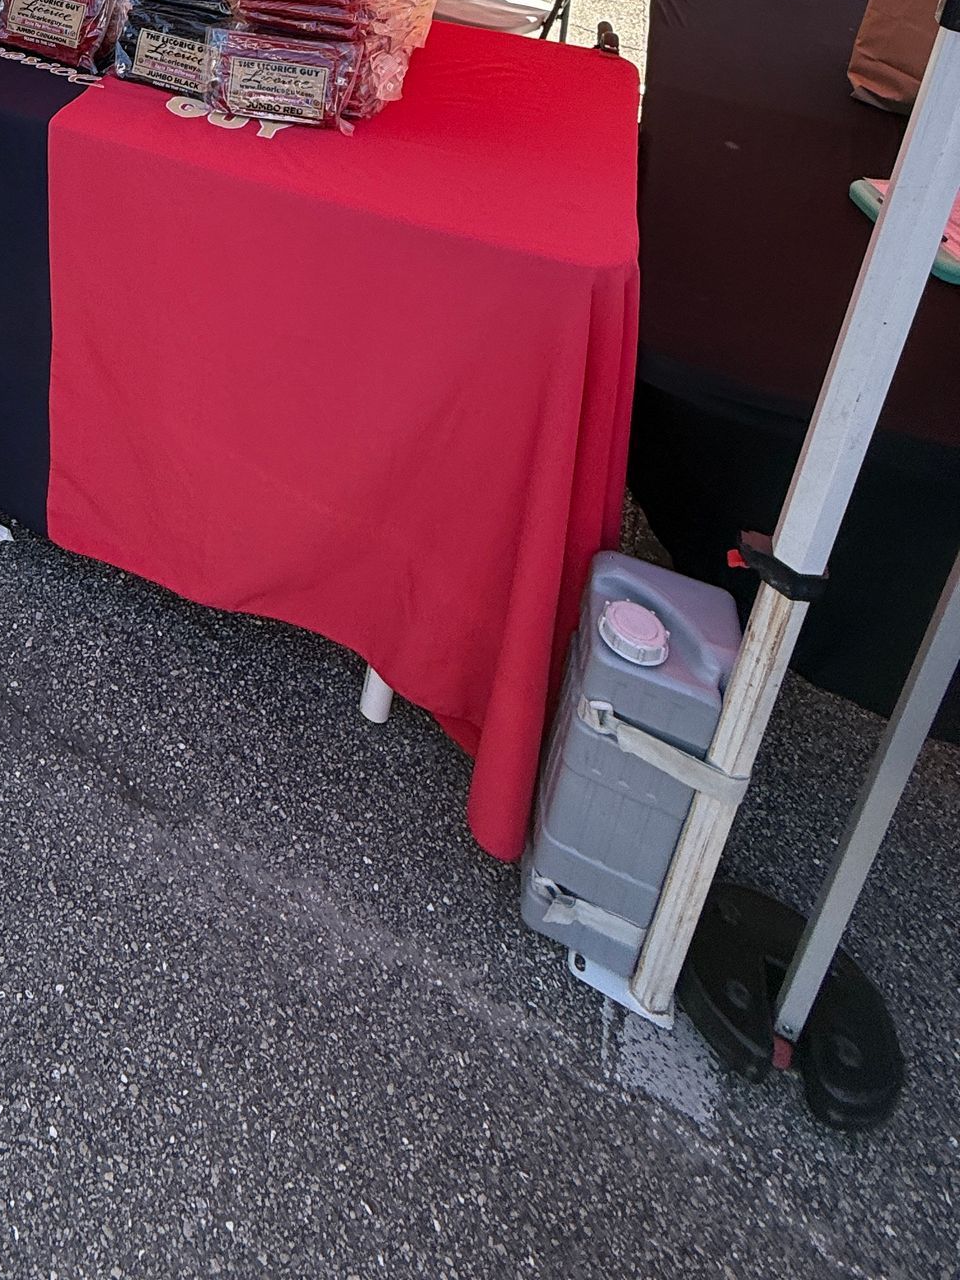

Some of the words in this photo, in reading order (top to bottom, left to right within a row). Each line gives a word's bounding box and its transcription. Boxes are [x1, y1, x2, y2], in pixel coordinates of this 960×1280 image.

[65, 3, 80, 12] GUY
[145, 32, 160, 41] THE
[161, 36, 196, 51] LICORICE
[299, 67, 321, 78] GUY
[146, 70, 173, 82] JUMBO
[174, 77, 200, 90] BLACK
[282, 106, 304, 115] RED
